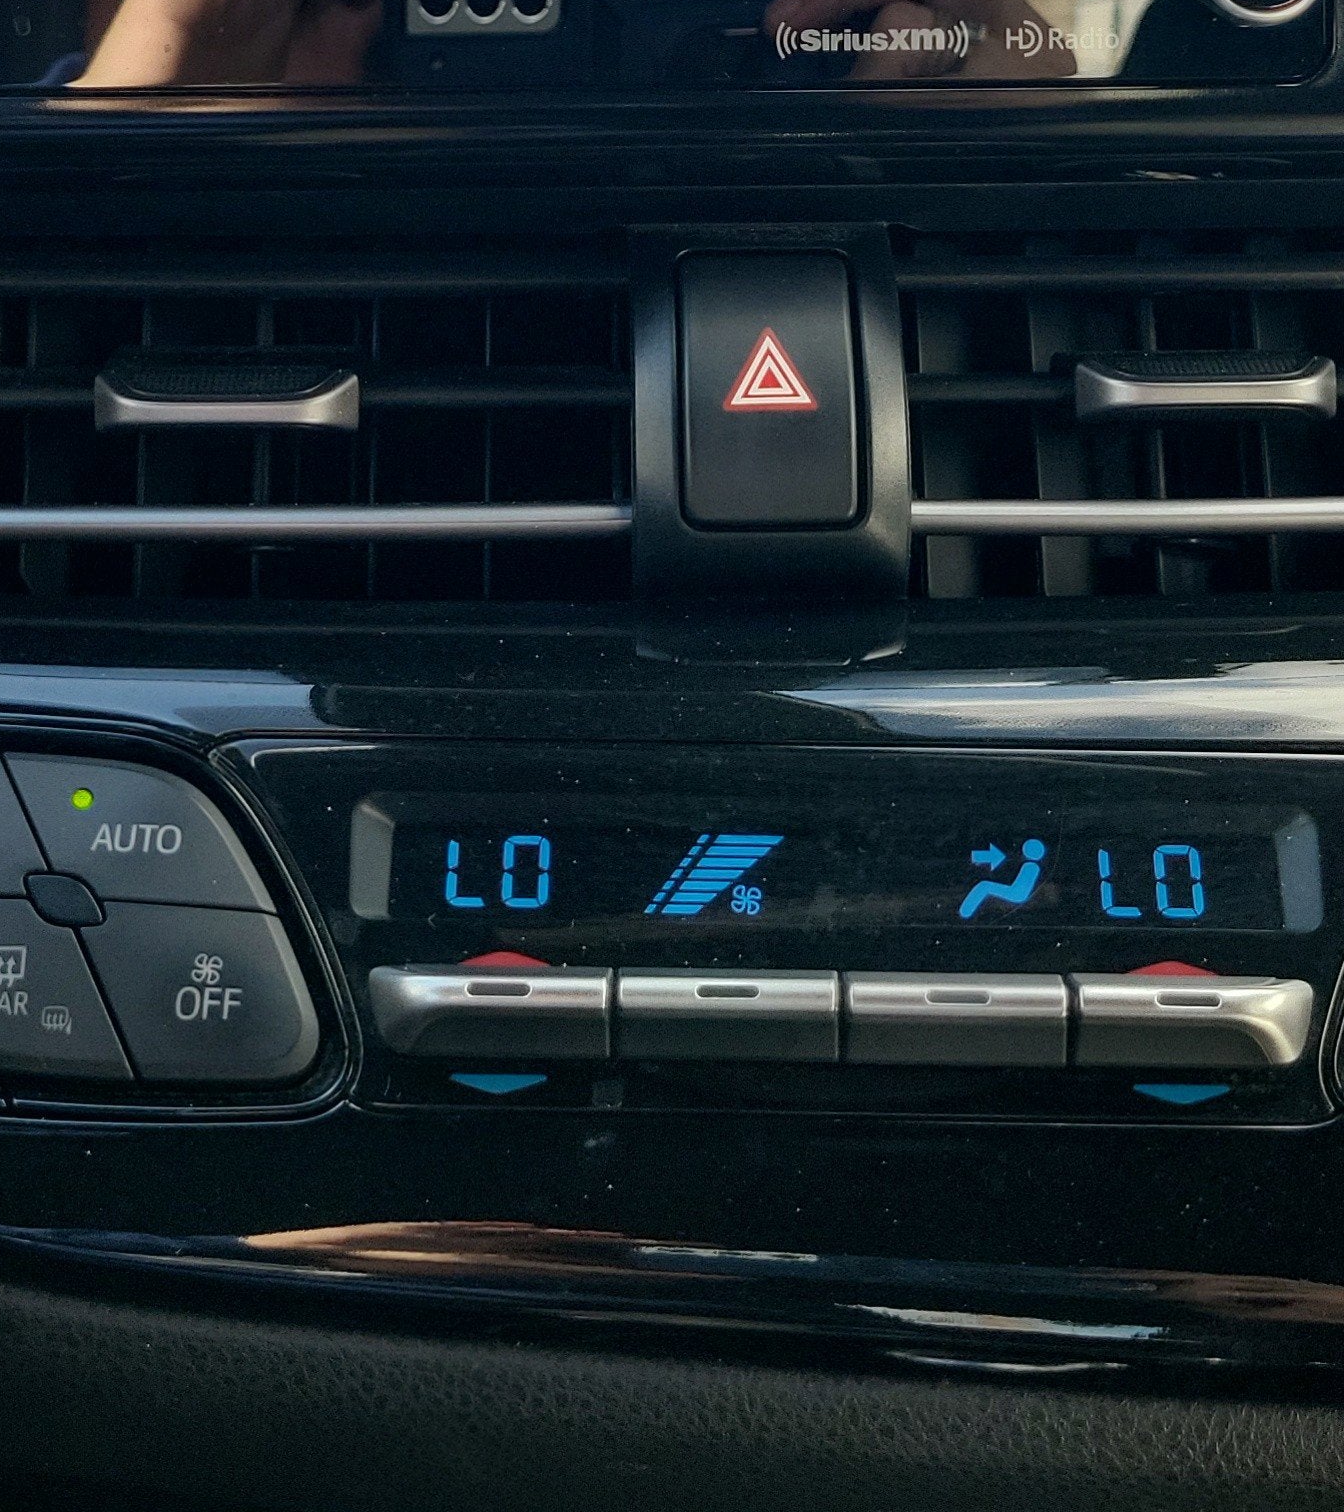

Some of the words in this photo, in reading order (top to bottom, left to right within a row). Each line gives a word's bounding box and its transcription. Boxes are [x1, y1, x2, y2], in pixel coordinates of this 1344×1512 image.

[1048, 27, 1120, 51] Radio
[90, 823, 183, 855] AUTO
[174, 986, 243, 1021] OFF
